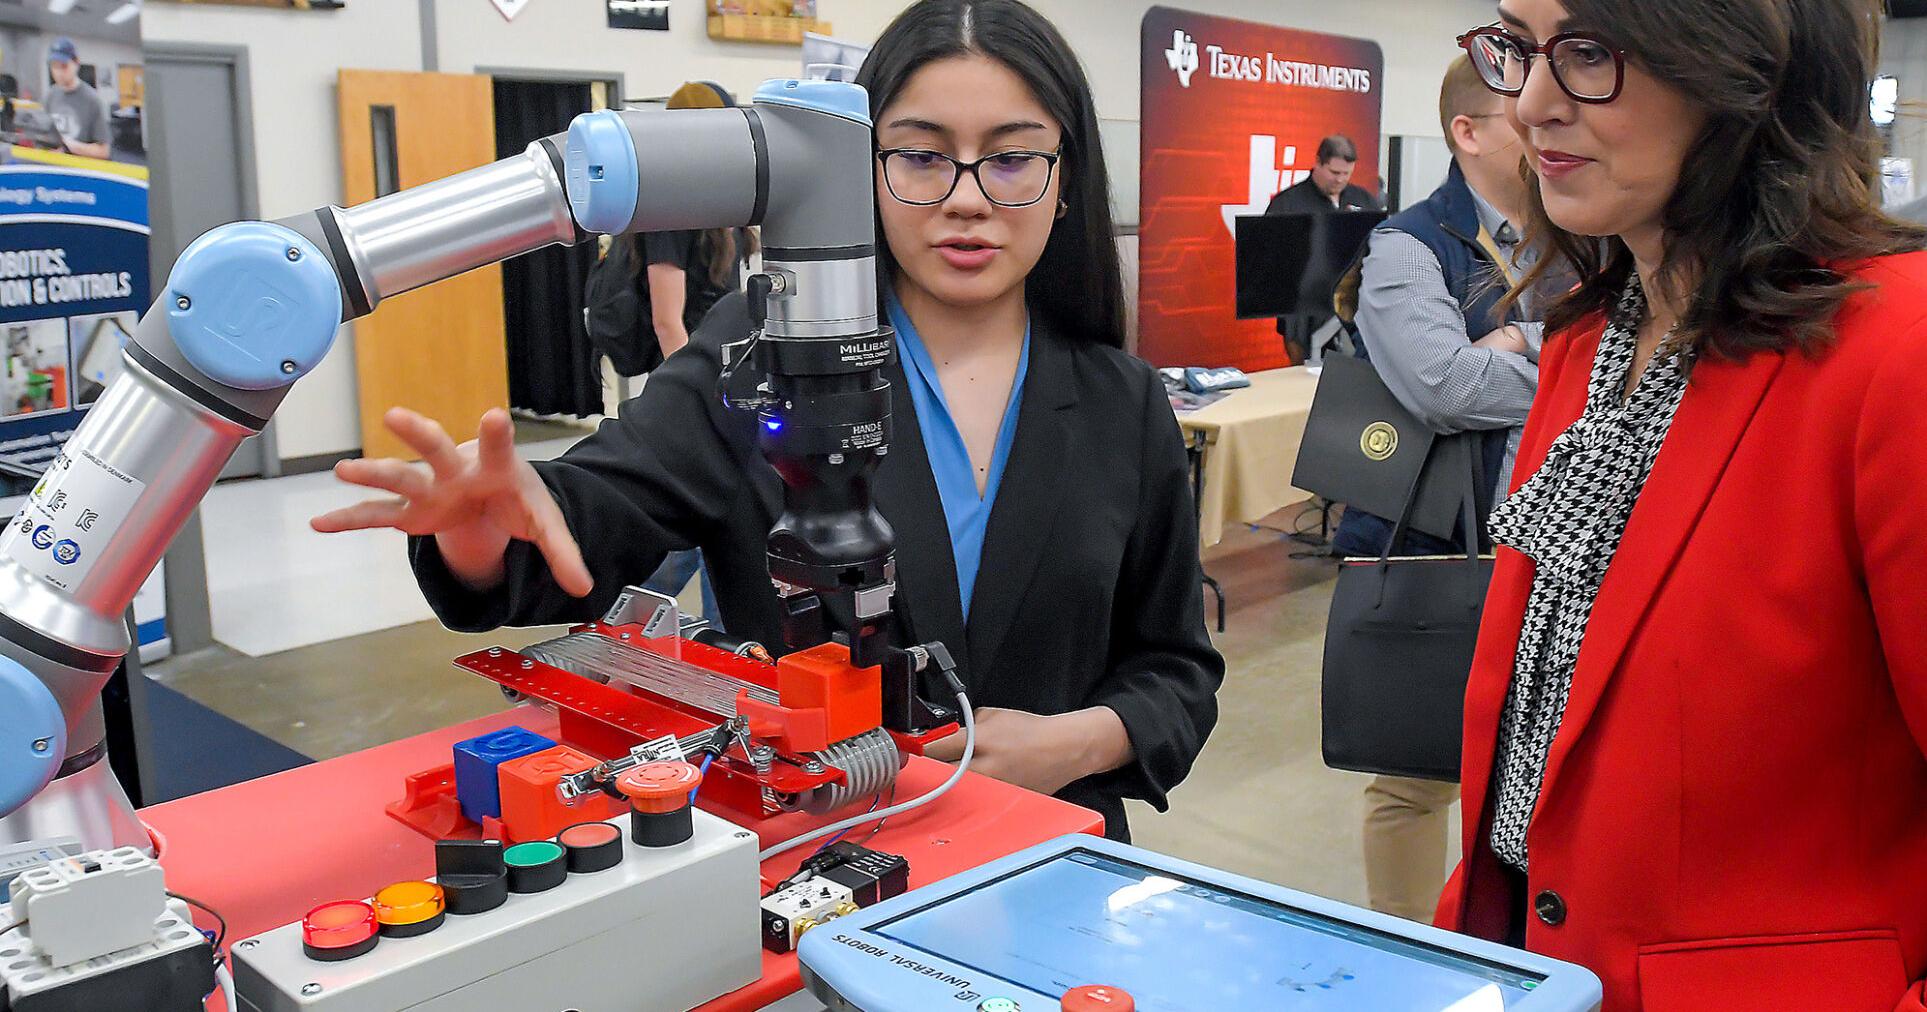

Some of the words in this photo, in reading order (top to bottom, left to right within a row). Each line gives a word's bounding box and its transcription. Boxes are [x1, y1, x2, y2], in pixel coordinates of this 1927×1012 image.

[35, 186, 97, 205] Systems
[32, 278, 47, 304] &
[48, 271, 132, 302] CONTROLS
[852, 421, 882, 434] HAND-E
[832, 934, 889, 958] ROBOTS
[889, 954, 971, 989] UNIVERSAL
